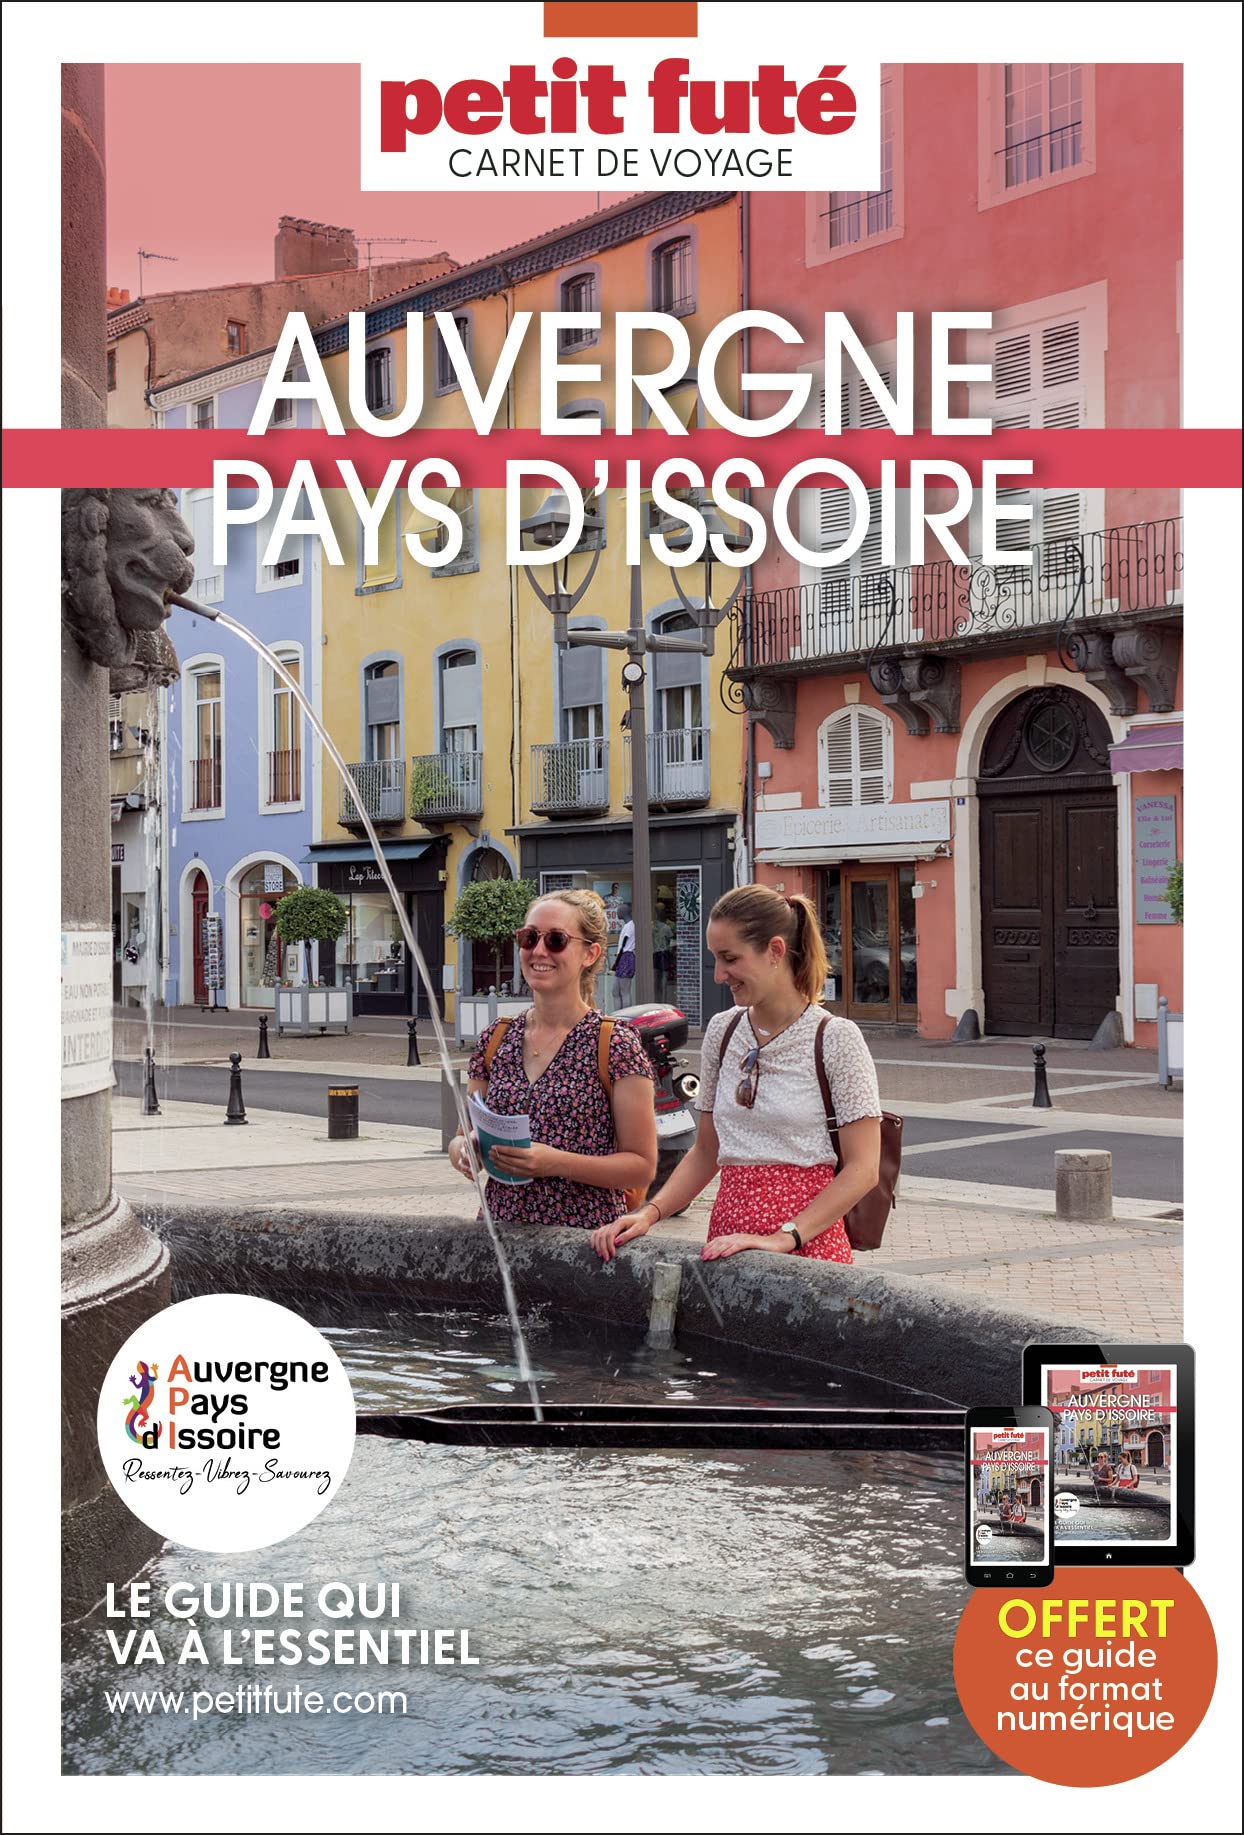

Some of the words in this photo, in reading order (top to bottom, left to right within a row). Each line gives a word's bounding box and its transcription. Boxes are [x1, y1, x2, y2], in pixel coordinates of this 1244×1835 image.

[1136, 800, 1174, 812] VANESSA
[265, 880, 283, 891] STORE
[64, 984, 79, 1000] EAU
[80, 983, 93, 999] NON
[1082, 1369, 1109, 1379] petit
[1111, 1369, 1135, 1378] futé
[1067, 1394, 1151, 1408] AUVERGNE
[1063, 1408, 1092, 1421] PAYS
[985, 1450, 1033, 1462] AUVERGNE
